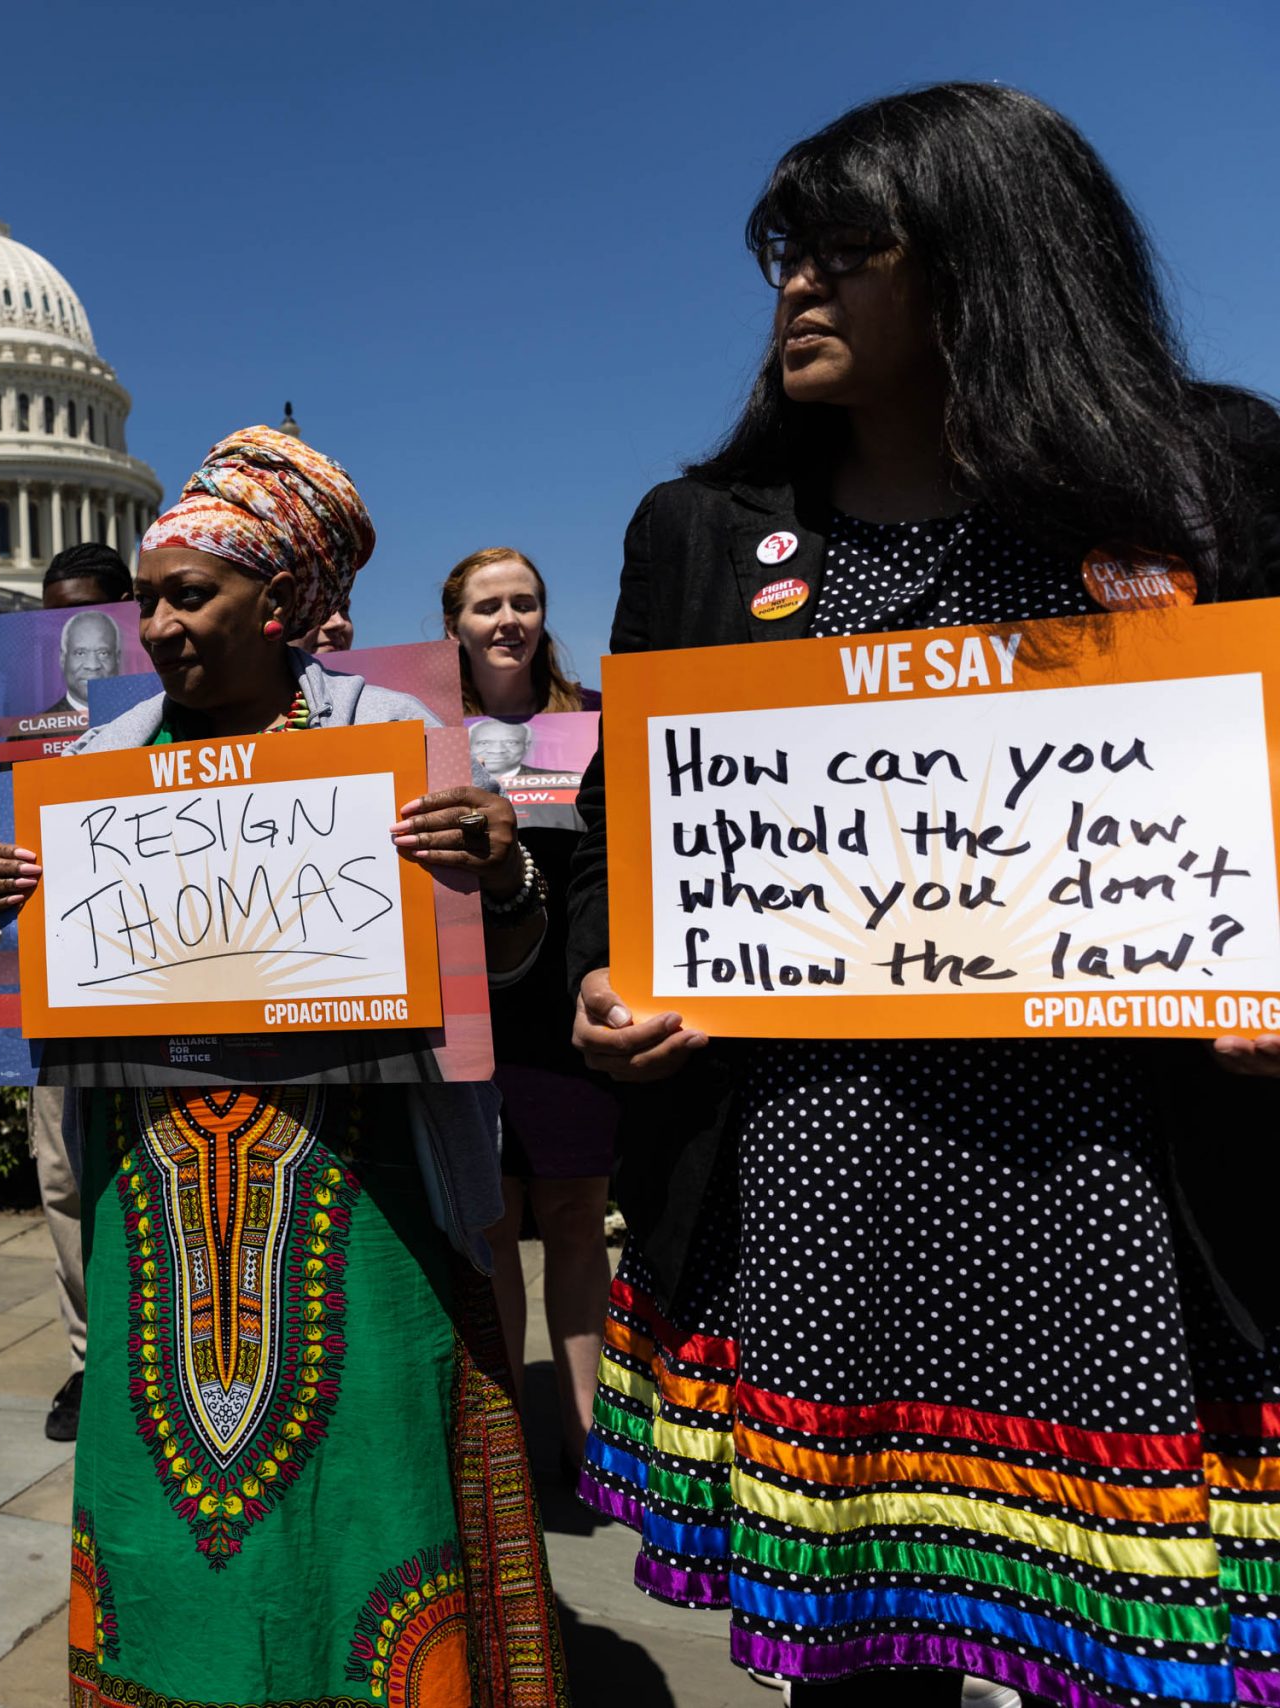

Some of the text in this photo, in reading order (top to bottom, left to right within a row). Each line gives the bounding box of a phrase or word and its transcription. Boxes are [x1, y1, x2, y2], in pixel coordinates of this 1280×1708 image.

[753, 586, 804, 608] POVERTY
[762, 579, 795, 596] FIGHT
[1104, 575, 1174, 602] ACTION
[758, 600, 799, 615] POOR PEOPLE
[839, 633, 1022, 696] WE SAY
[18, 715, 89, 731] CLARENC
[149, 742, 256, 788] WE SAY
[665, 727, 1154, 810] How can you
[502, 775, 581, 786] THOMAS
[81, 787, 338, 873] RESIGN
[673, 800, 1187, 873] uphold the law
[676, 846, 1251, 930] when you don't
[61, 856, 393, 968] THOMAS
[673, 914, 1244, 991] follow the law?
[264, 998, 408, 1025] CPDACTION.ORG
[1024, 995, 1280, 1029] CPDACTION.ORG
[169, 1037, 217, 1045] ALLIANCE
[170, 1046, 189, 1054] FOR
[170, 1054, 211, 1063] JUSTICE
